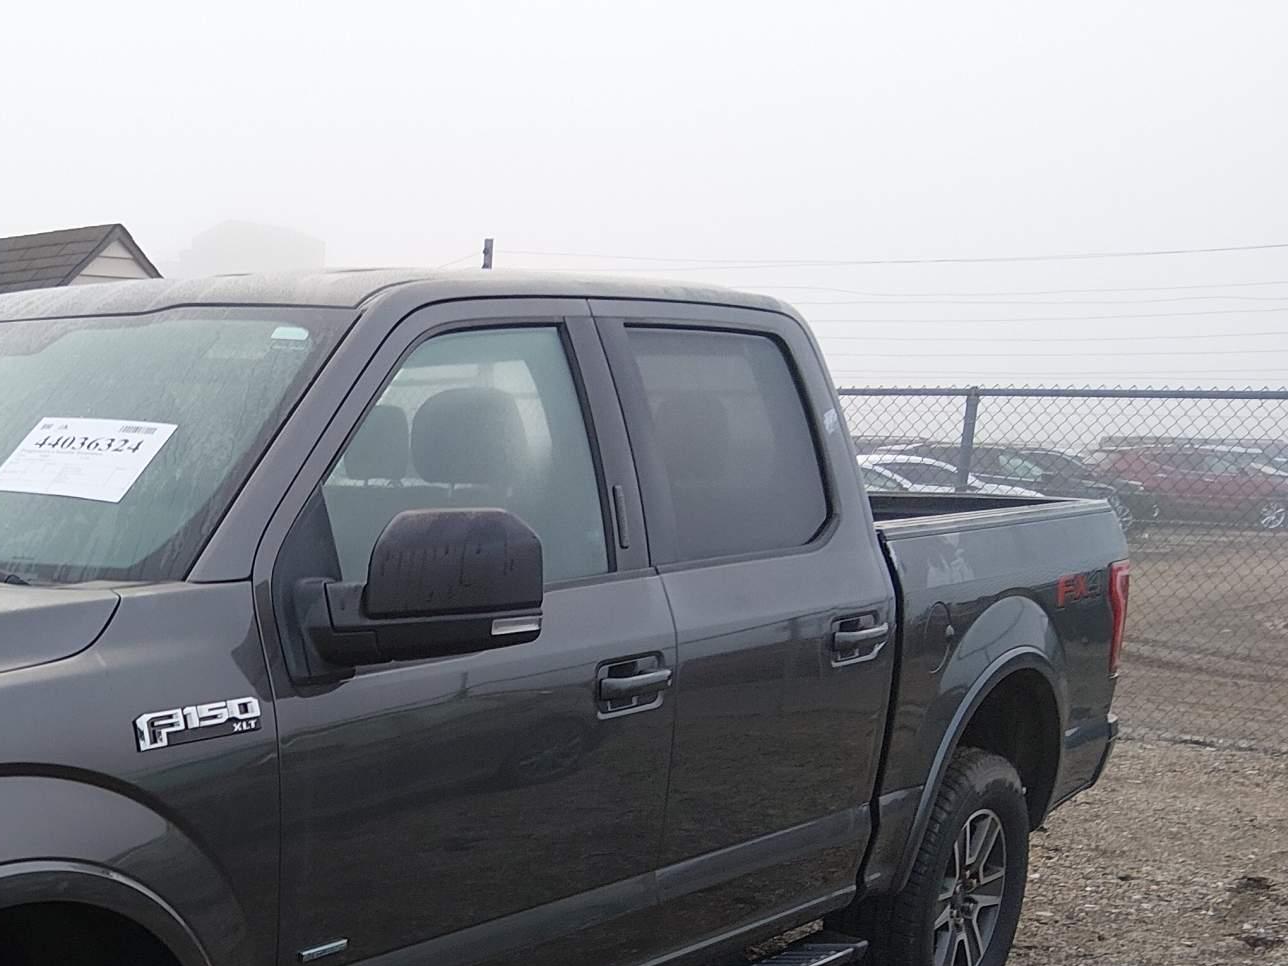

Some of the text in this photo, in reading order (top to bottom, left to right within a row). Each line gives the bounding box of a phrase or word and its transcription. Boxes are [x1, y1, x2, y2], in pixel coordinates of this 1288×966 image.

[33, 434, 145, 453] 44036324
[1056, 571, 1101, 608] FX4
[231, 718, 258, 733] XLT
